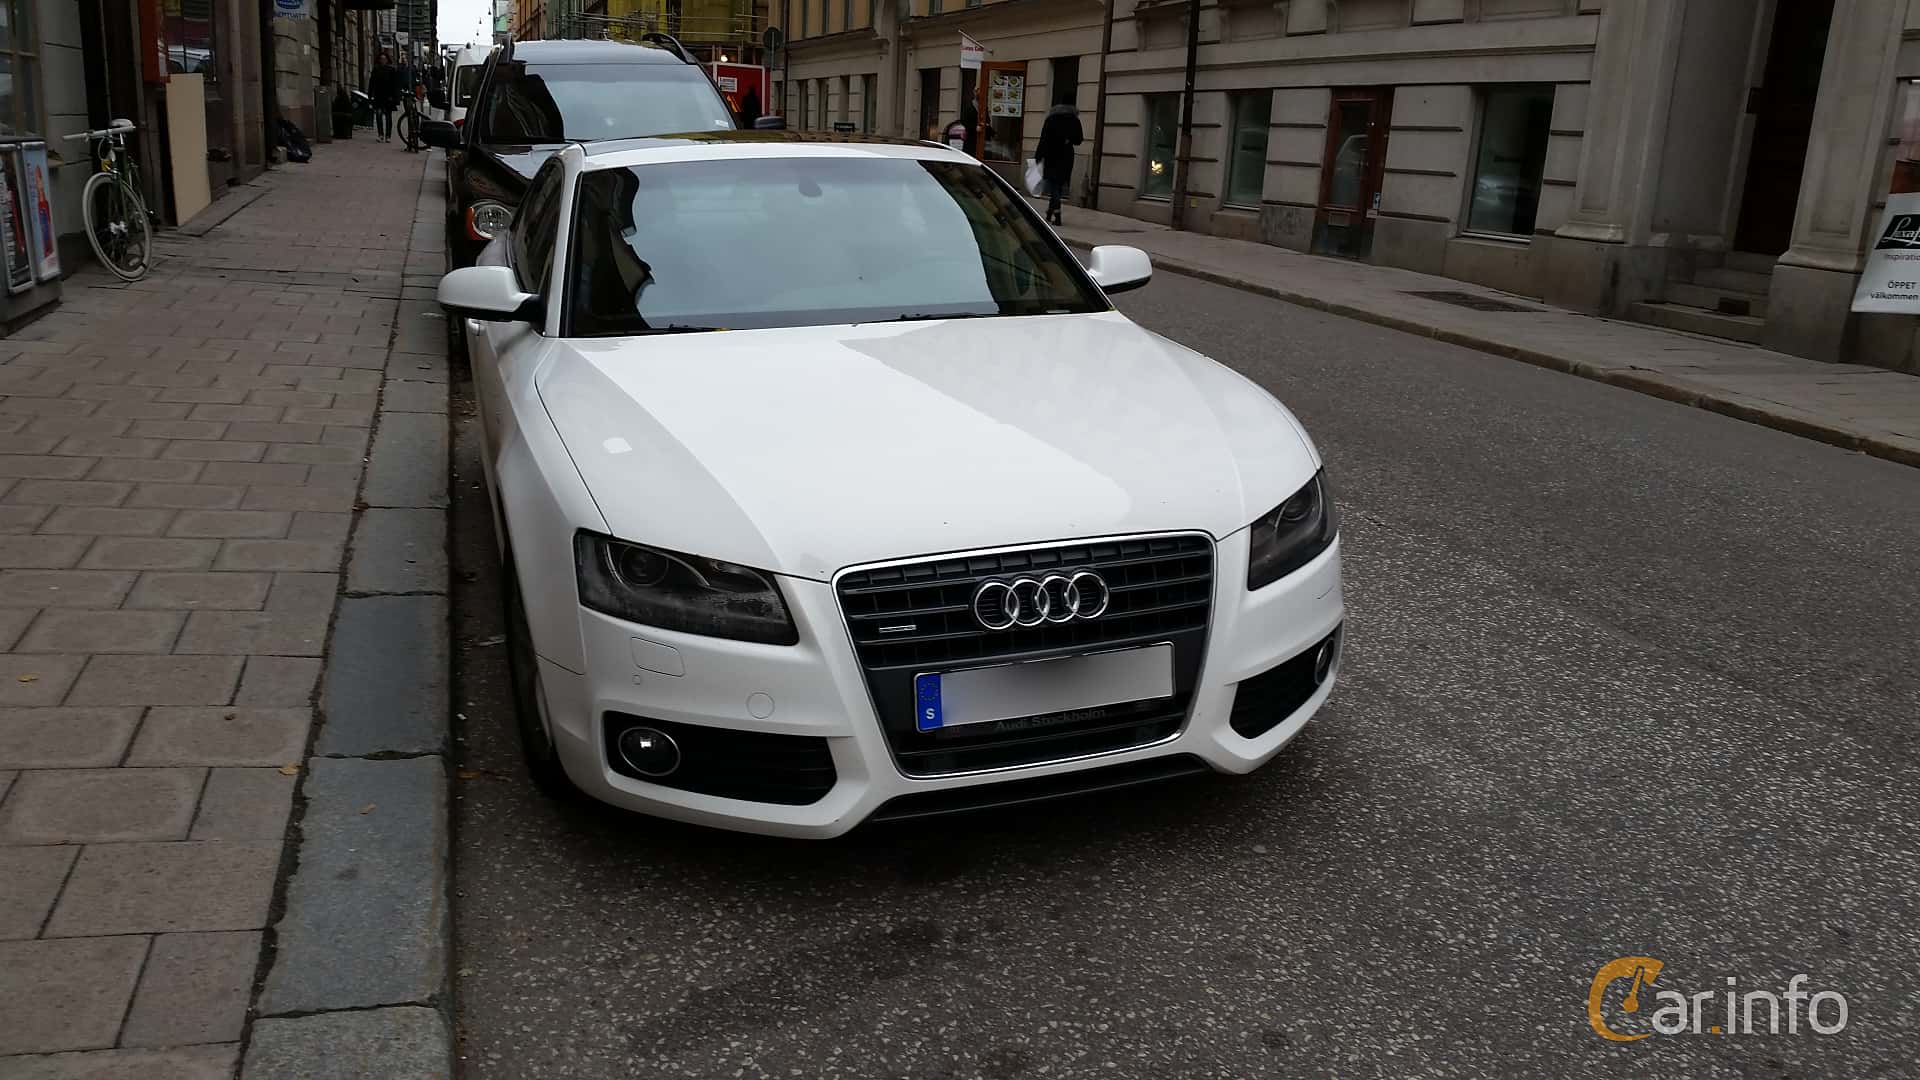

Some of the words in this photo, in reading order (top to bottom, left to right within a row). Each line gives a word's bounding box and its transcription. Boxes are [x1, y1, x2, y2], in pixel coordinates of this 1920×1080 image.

[1887, 279, 1916, 290] ÖPPET
[1870, 291, 1918, 300] välkommen
[926, 708, 935, 719] S
[996, 717, 1027, 730] Audi
[1031, 708, 1106, 728] Stockholm
